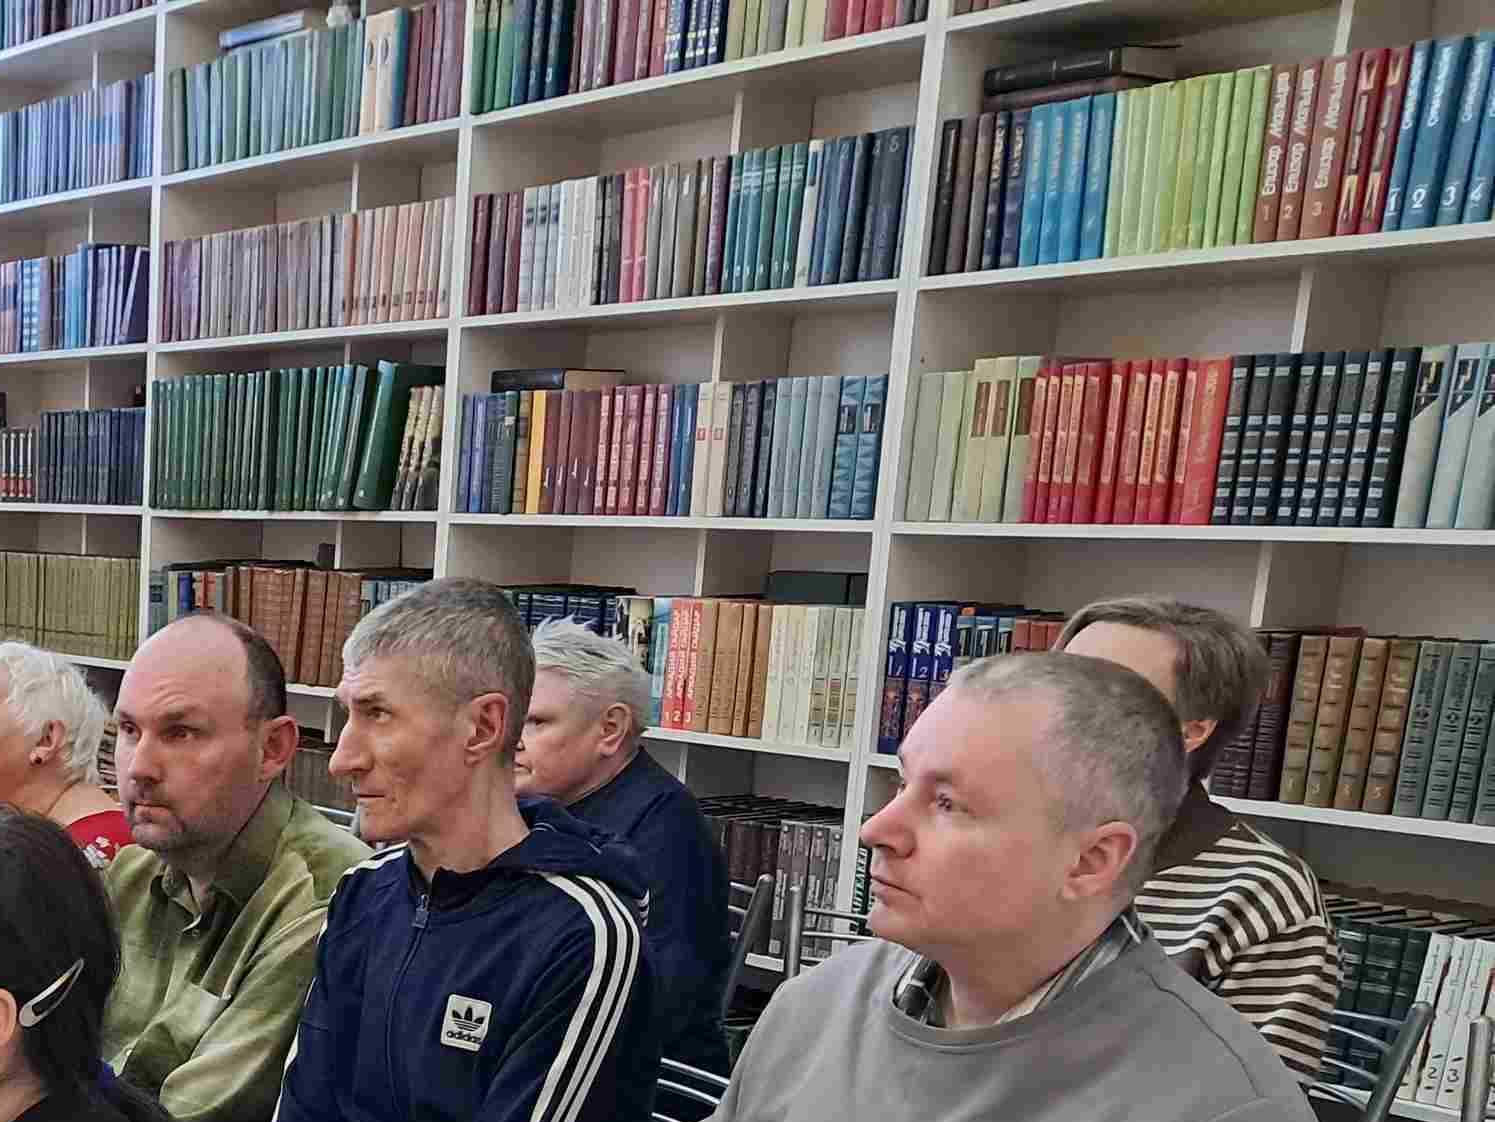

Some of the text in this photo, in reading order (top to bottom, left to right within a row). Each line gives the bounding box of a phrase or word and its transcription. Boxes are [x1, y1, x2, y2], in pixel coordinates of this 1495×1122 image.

[1412, 188, 1427, 208] 2
[1443, 185, 1457, 206] 3
[1283, 205, 1294, 219] 2
[1311, 201, 1323, 216] 3
[919, 667, 929, 679] 2
[1426, 1067, 1438, 1080] 2
[1446, 1068, 1459, 1083] 3
